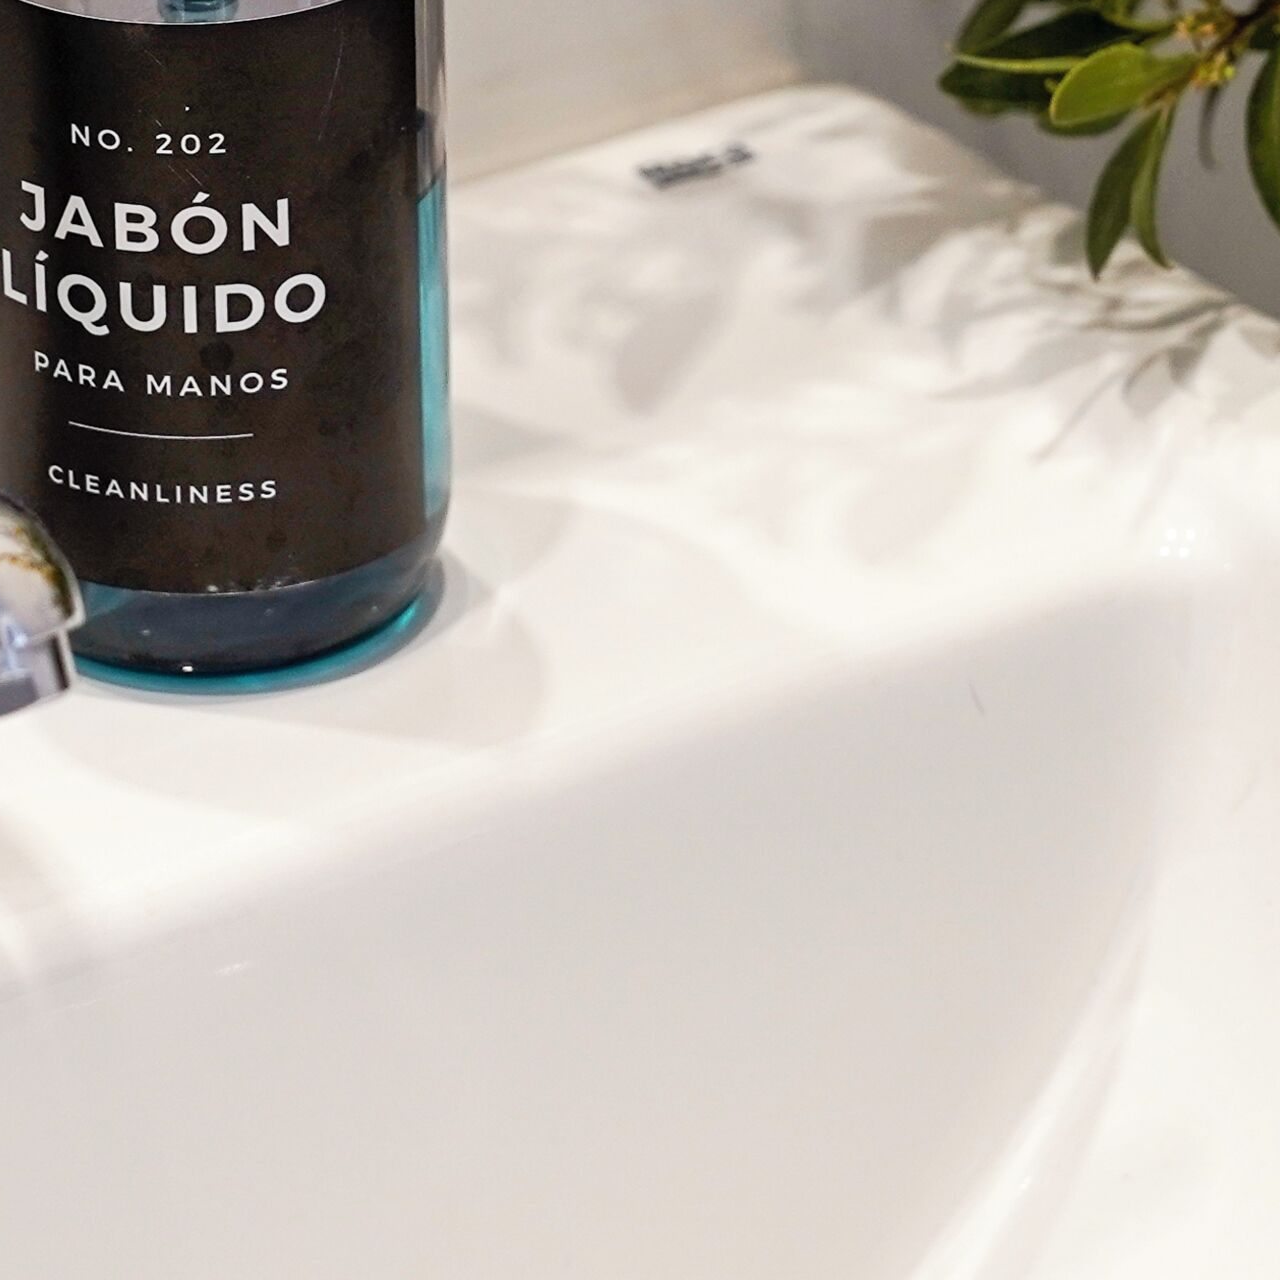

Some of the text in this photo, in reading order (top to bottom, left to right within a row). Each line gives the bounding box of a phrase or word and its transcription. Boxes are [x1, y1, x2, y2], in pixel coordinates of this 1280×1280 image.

[70, 122, 228, 155] NO. 202
[19, 180, 291, 255] JABÓN
[1, 248, 327, 337] LÍQUIDO
[33, 350, 289, 397] PARA MANOS
[48, 464, 278, 504] CLEANLINESS
